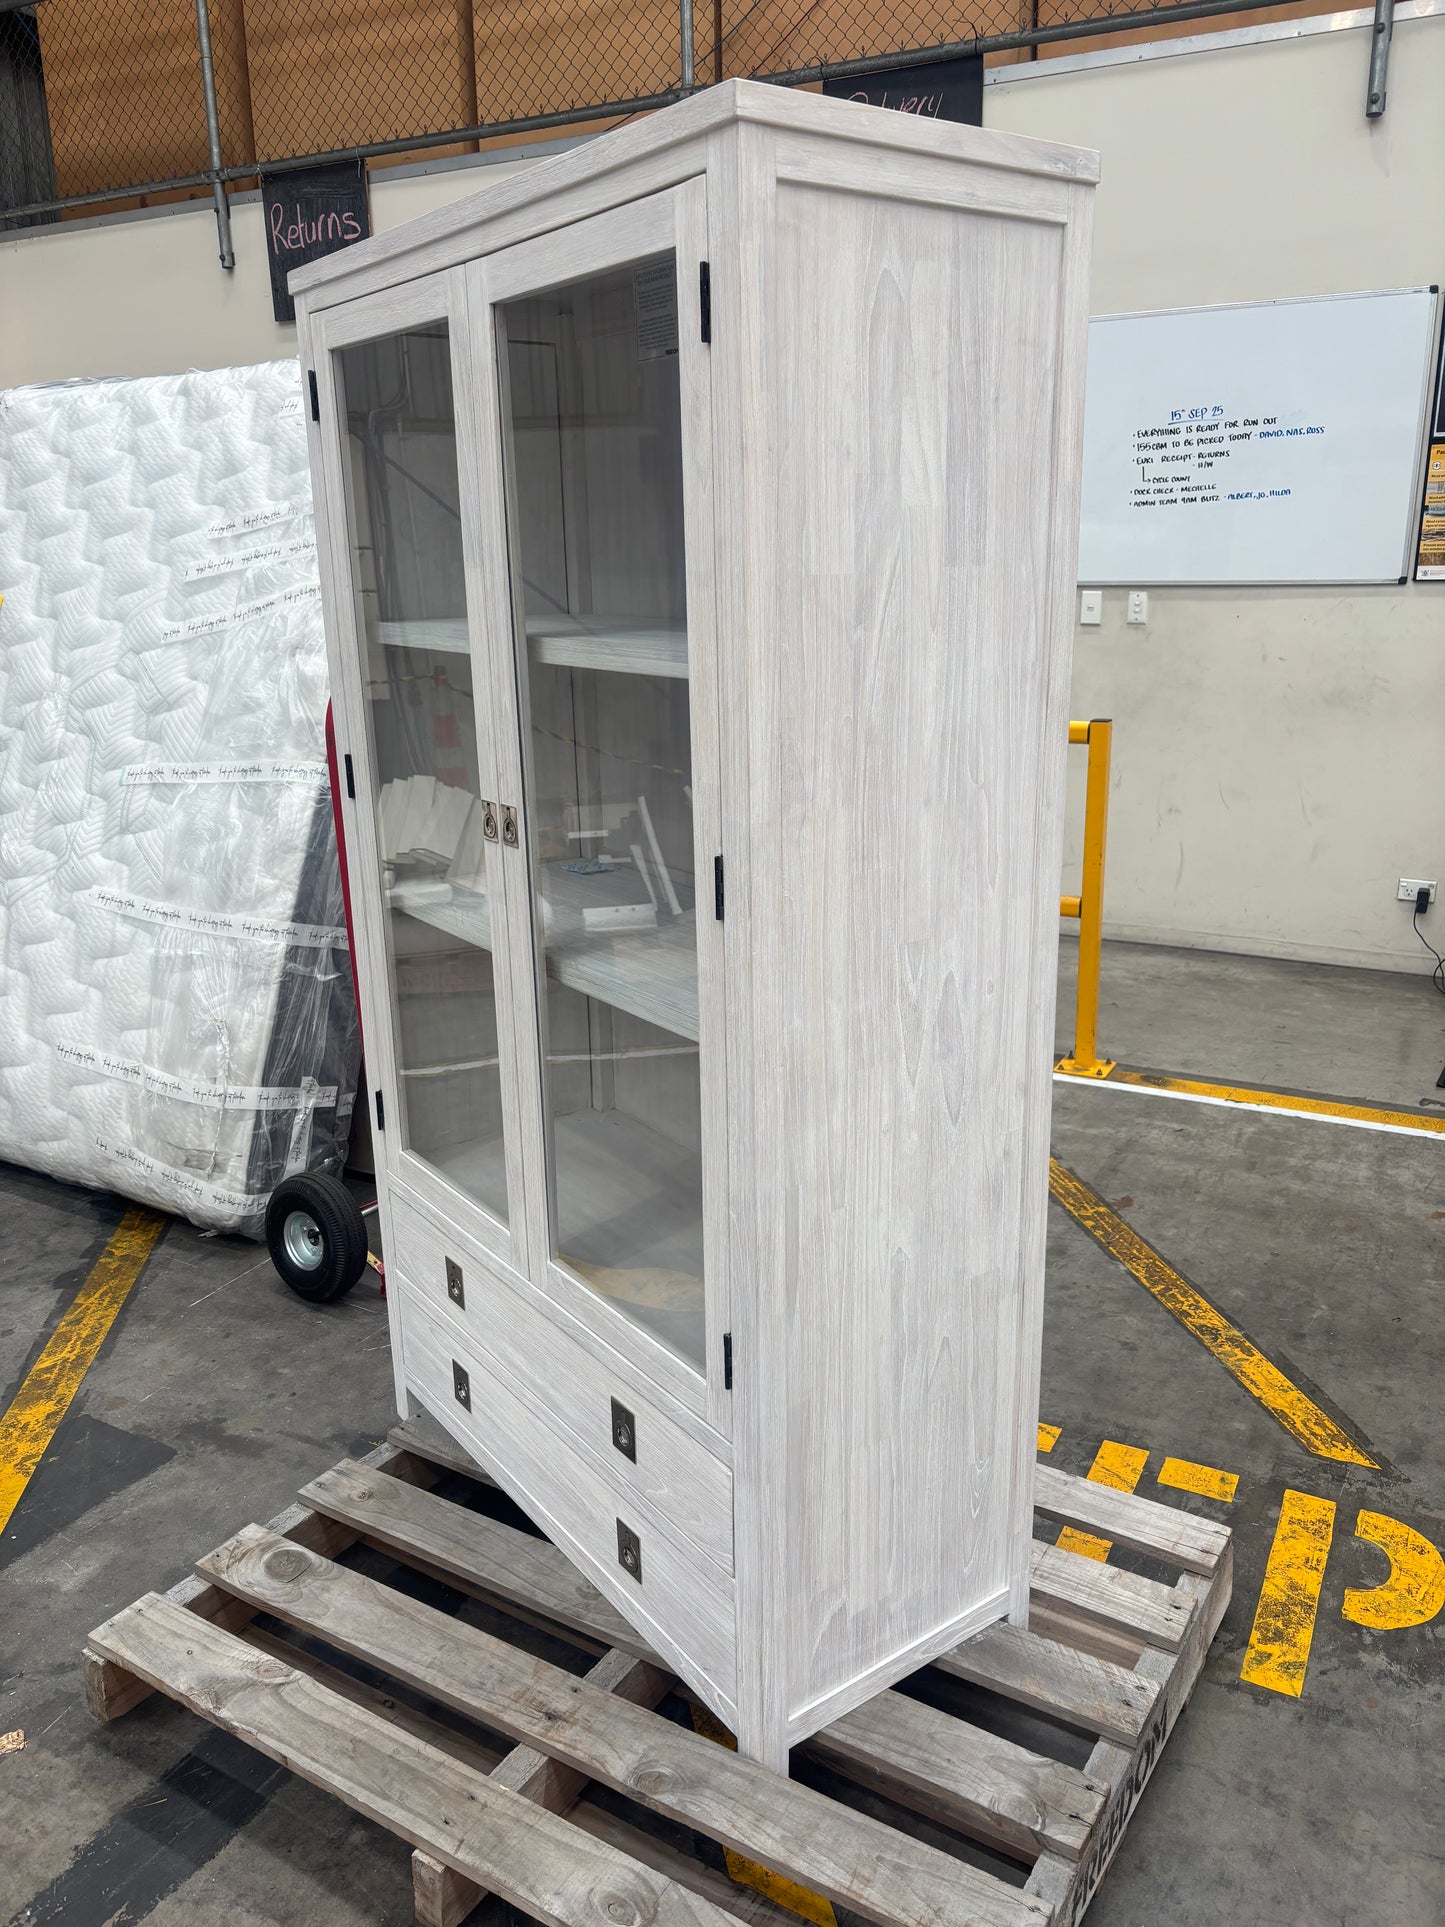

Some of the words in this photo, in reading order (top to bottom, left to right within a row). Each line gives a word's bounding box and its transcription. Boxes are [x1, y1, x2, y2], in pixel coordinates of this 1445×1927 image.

[271, 202, 362, 256] Returns
[1188, 406, 1208, 420] SEP
[1212, 405, 1224, 417] 25
[1137, 427, 1182, 438] EVERYTHING
[1186, 425, 1193, 434] IS
[1196, 422, 1220, 432] READY
[1224, 420, 1240, 429] FOR
[1243, 418, 1259, 427] RUN
[1263, 416, 1278, 425] OUT
[1172, 440, 1181, 449] TO
[1197, 436, 1225, 446] PICKED
[1229, 431, 1253, 442] TODAY
[1306, 426, 1326, 435] ROSS
[1159, 498, 1178, 506] TEAM
